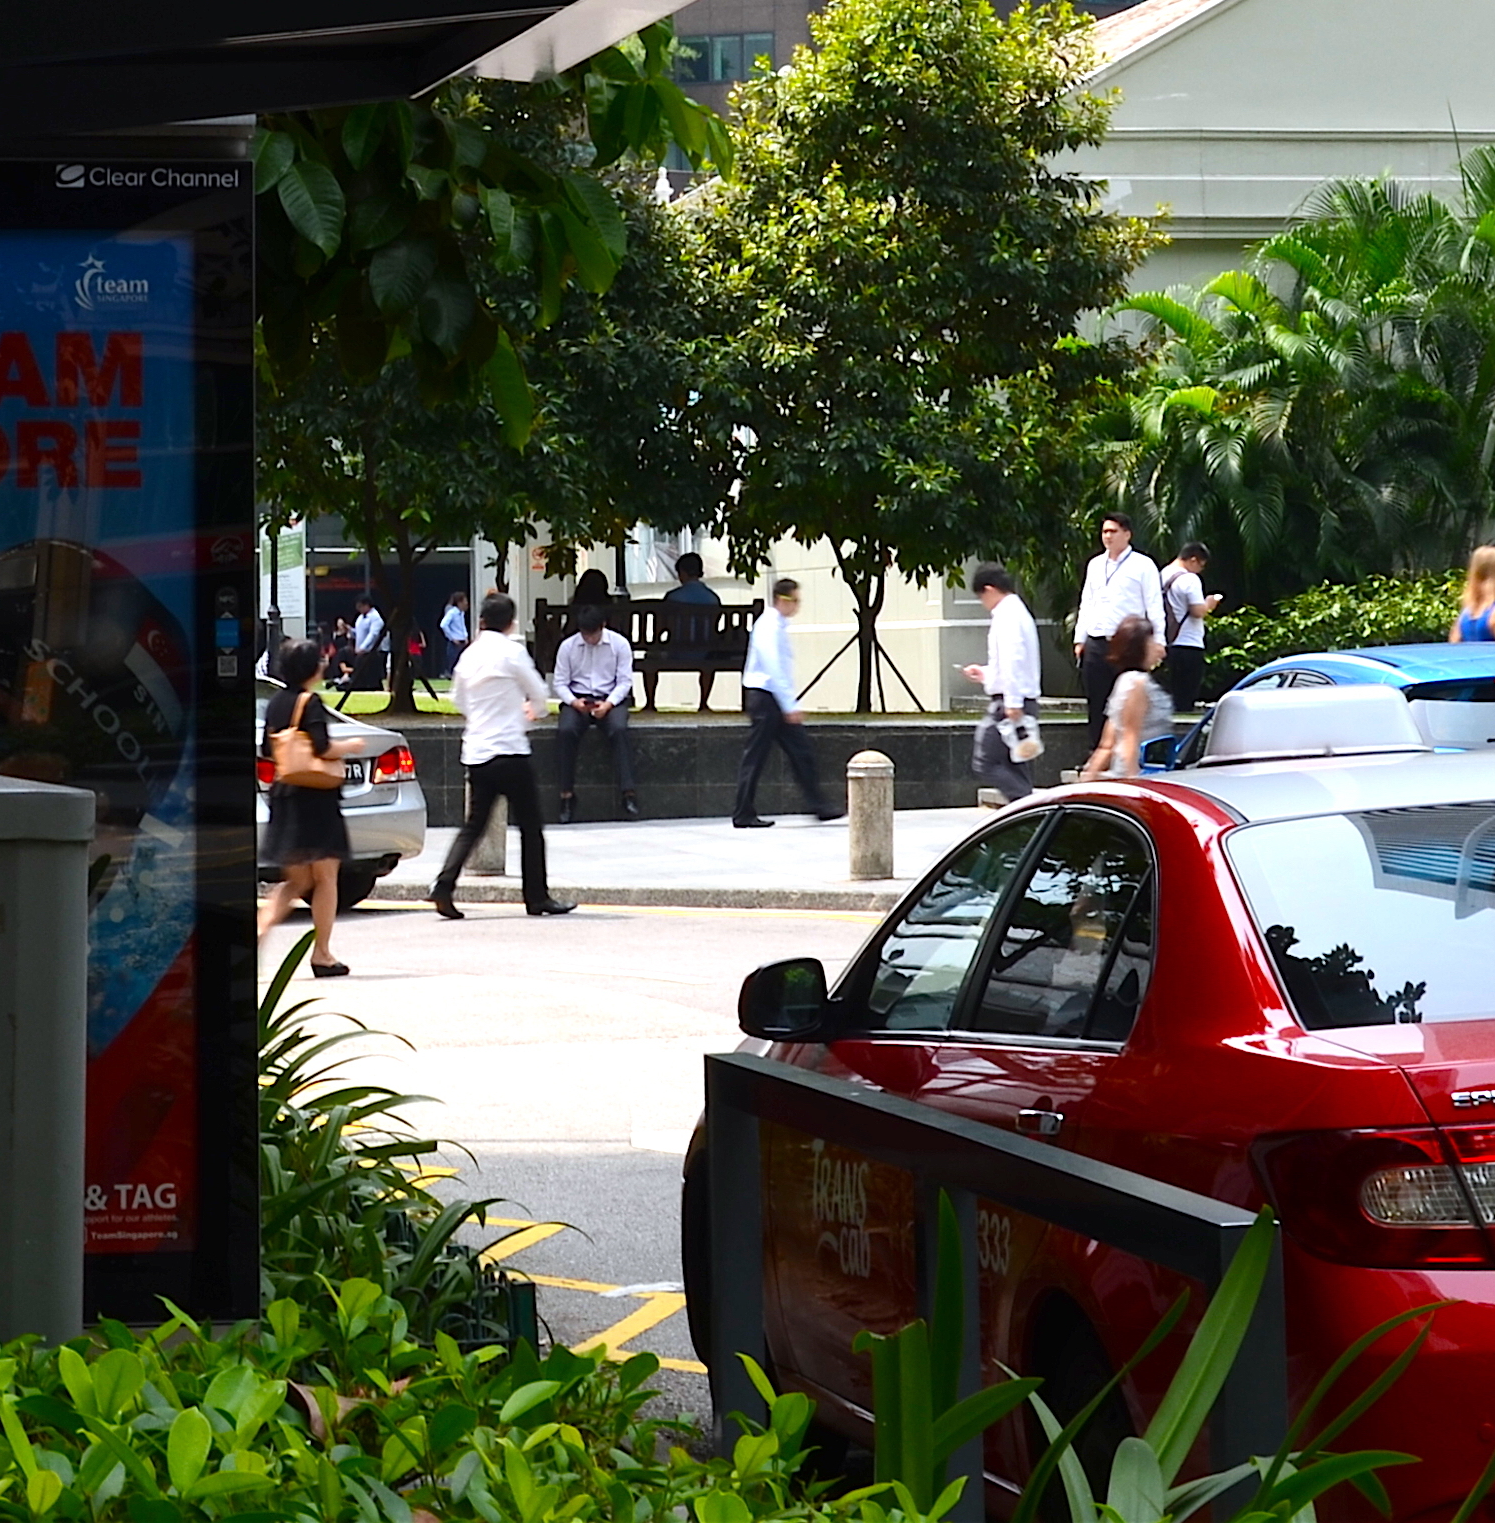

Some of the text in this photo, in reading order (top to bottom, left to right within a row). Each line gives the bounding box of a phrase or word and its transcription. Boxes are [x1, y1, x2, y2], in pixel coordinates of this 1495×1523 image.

[89, 167, 240, 189] Clear Channel
[96, 276, 149, 294] team
[84, 1182, 178, 1212] & TAG
